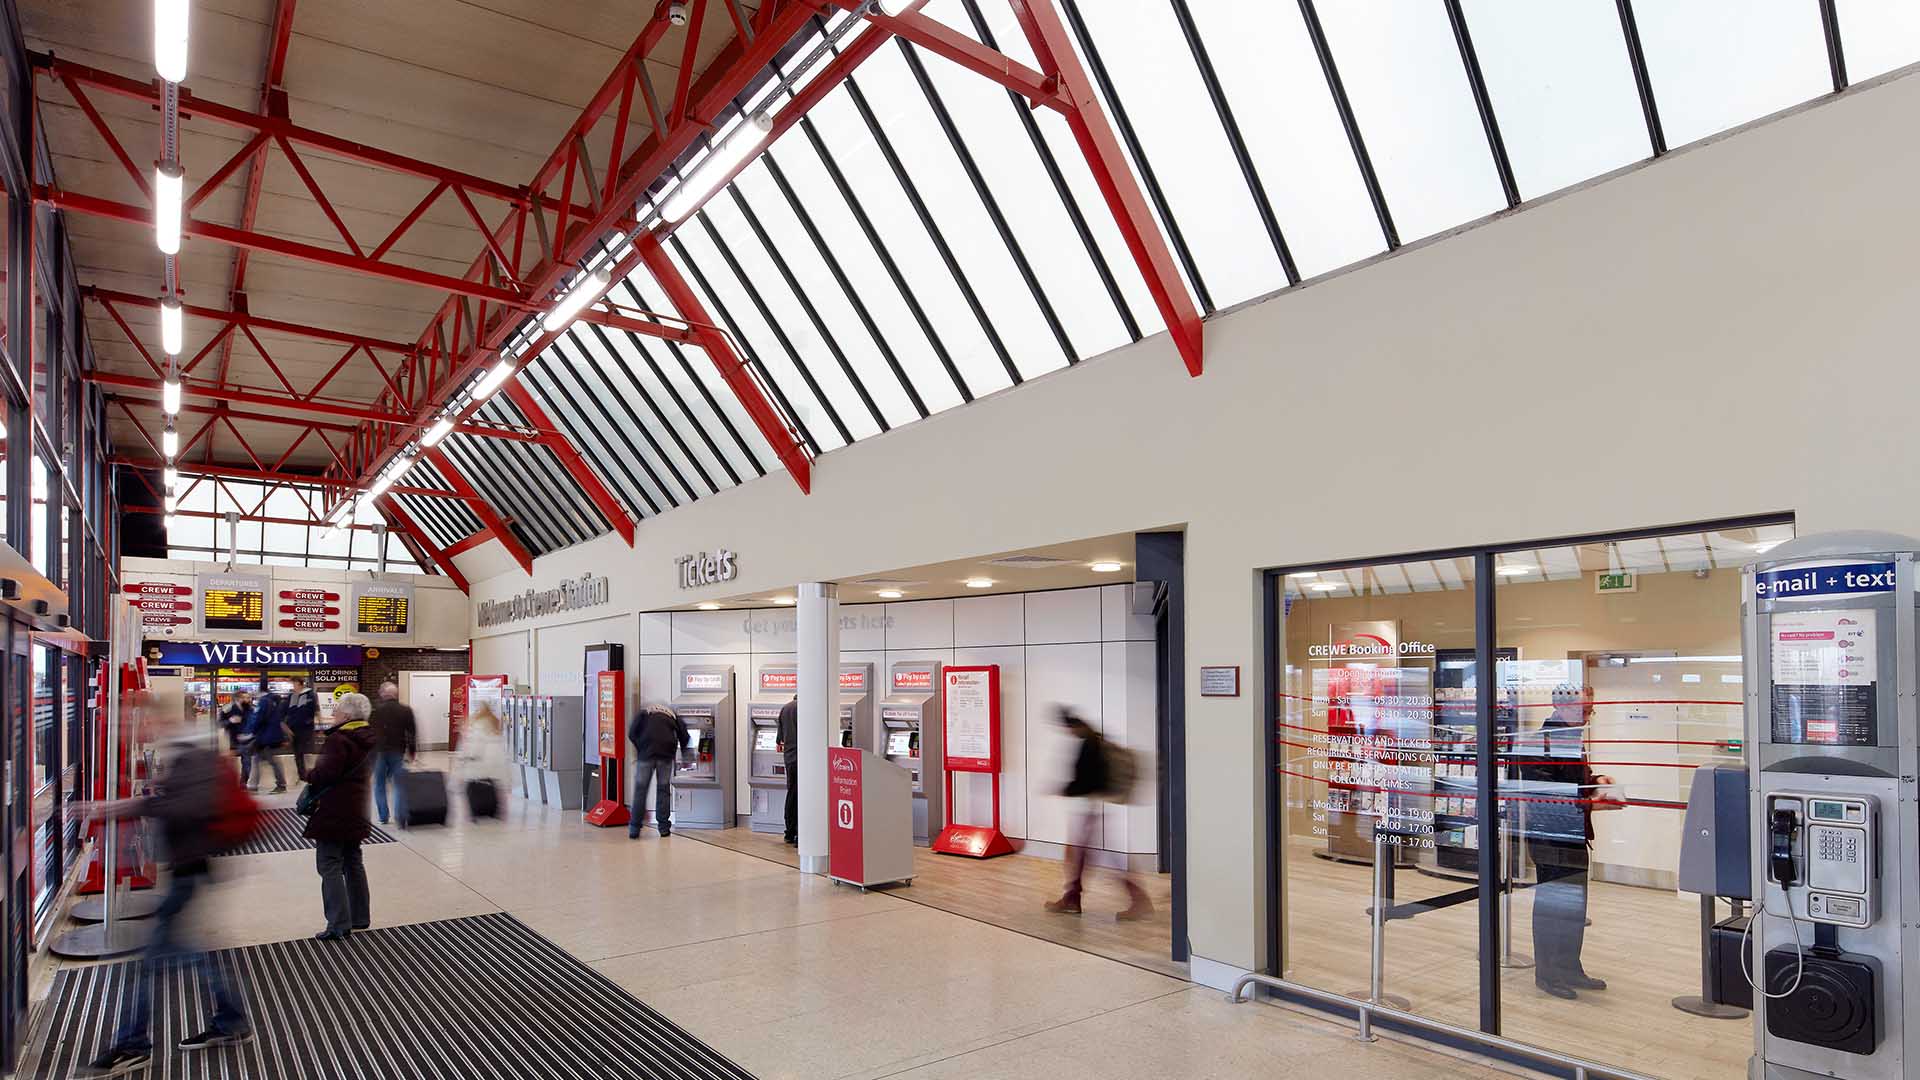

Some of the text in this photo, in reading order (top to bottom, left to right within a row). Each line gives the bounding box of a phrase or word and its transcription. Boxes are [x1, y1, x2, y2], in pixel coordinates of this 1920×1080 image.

[674, 548, 738, 589] Tickets
[1756, 572, 1817, 594] e-mail
[1844, 570, 1896, 588] text
[141, 586, 175, 594] CREWE
[295, 592, 325, 600] CREWE
[140, 601, 175, 609] CREWE
[477, 600, 513, 628] Welcome
[560, 572, 609, 612] Station
[295, 606, 325, 614] CREWE
[743, 618, 769, 634] Get
[771, 618, 797, 635] you
[862, 614, 896, 630] here
[201, 643, 329, 665] WHSmith
[1308, 642, 1435, 656] CREWE Booking Office
[1337, 695, 1350, 704] Sat
[1374, 696, 1399, 705] 05.30
[1406, 696, 1433, 706] 20.30
[1407, 710, 1434, 719] 20.30
[1312, 734, 1432, 747] RESERVATIONS AND TICKETS
[1306, 747, 1440, 763] REQUIRING RESERVATIONS CAN
[1312, 760, 1334, 770] ONLY
[1335, 761, 1345, 770] BE
[1330, 774, 1381, 787] FOLLOWING
[1313, 800, 1331, 809] Mon
[1337, 801, 1349, 811] Fri
[1408, 808, 1434, 821] 19.00
[1312, 812, 1325, 822] Sat
[1375, 819, 1401, 831] 09.00
[1408, 823, 1434, 835] 17.00
[1312, 825, 1328, 835] Sun
[1376, 832, 1401, 844] 09.00
[1409, 837, 1435, 849] 17.00
